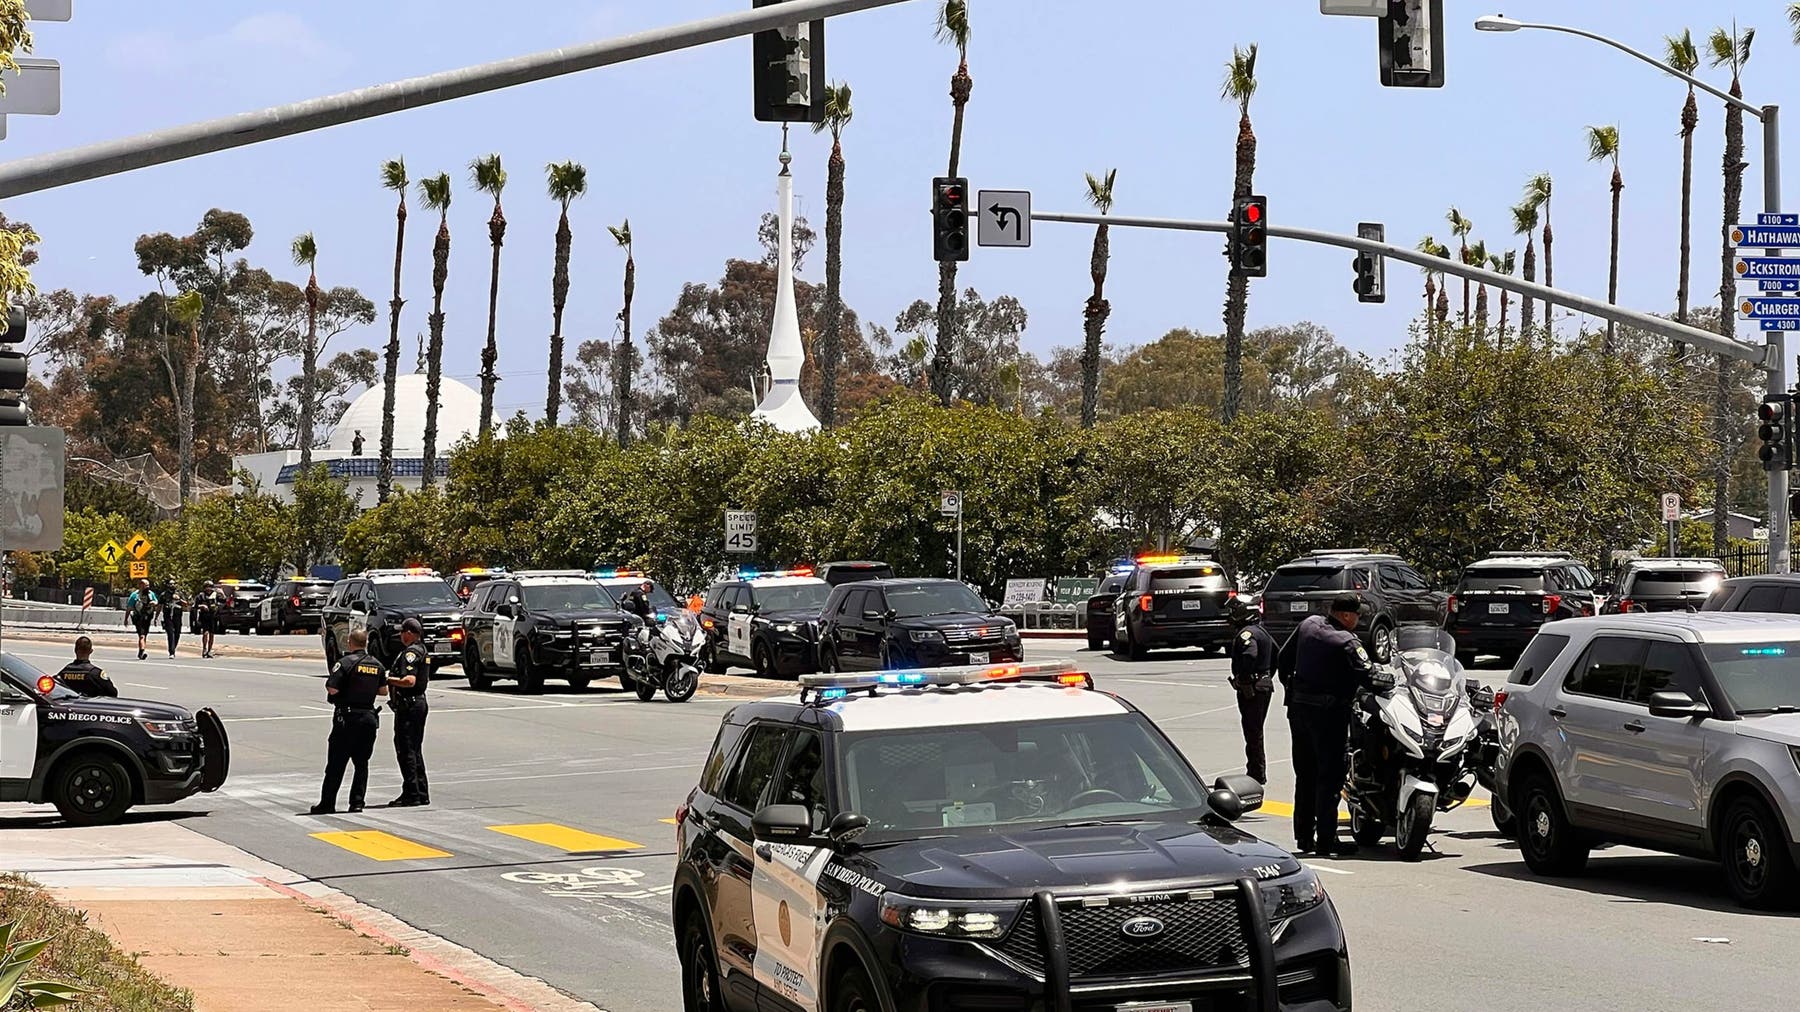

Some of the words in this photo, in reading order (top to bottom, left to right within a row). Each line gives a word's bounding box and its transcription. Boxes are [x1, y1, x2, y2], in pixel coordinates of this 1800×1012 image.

[1762, 216, 1781, 225] 4100
[1748, 230, 1800, 243] HATHAWAY
[1750, 262, 1800, 275] ECKSTROM
[1763, 281, 1782, 290] 7000
[1755, 302, 1800, 315] CHARGER
[1777, 321, 1795, 329] 4300
[729, 533, 753, 548] 45
[133, 563, 145, 571] 35
[1072, 587, 1080, 595] AD
[358, 665, 378, 675] POLICE
[48, 712, 66, 720] SAN
[68, 713, 97, 722] DIEGO
[100, 715, 132, 724] POLICE
[824, 862, 841, 879] SAN
[837, 866, 861, 885] DIEGO
[855, 875, 886, 897] POLICE
[1130, 894, 1171, 903] SETINA
[1133, 922, 1155, 932] Ford
[774, 962, 783, 976] TO
[780, 966, 804, 987] PROTECT
